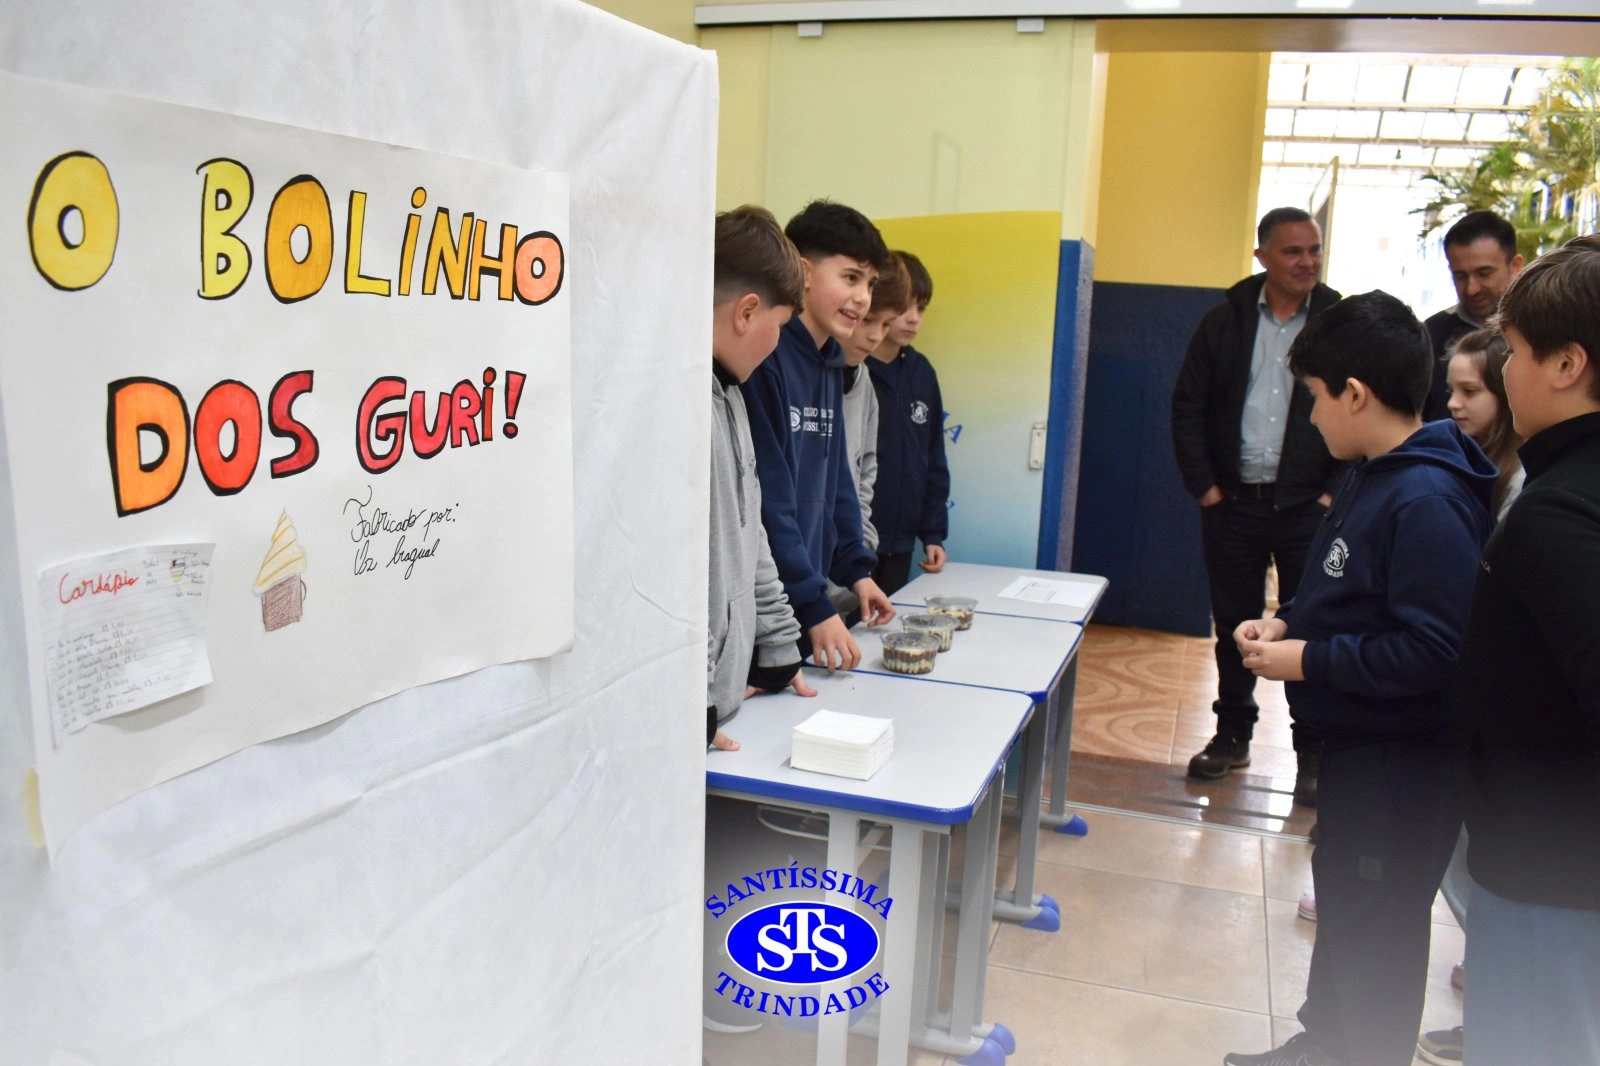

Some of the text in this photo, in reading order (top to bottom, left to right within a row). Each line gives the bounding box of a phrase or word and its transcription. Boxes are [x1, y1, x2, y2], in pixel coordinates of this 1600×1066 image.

[27, 150, 120, 291] O
[107, 370, 320, 516] DOS
[59, 570, 139, 604] Cardápio
